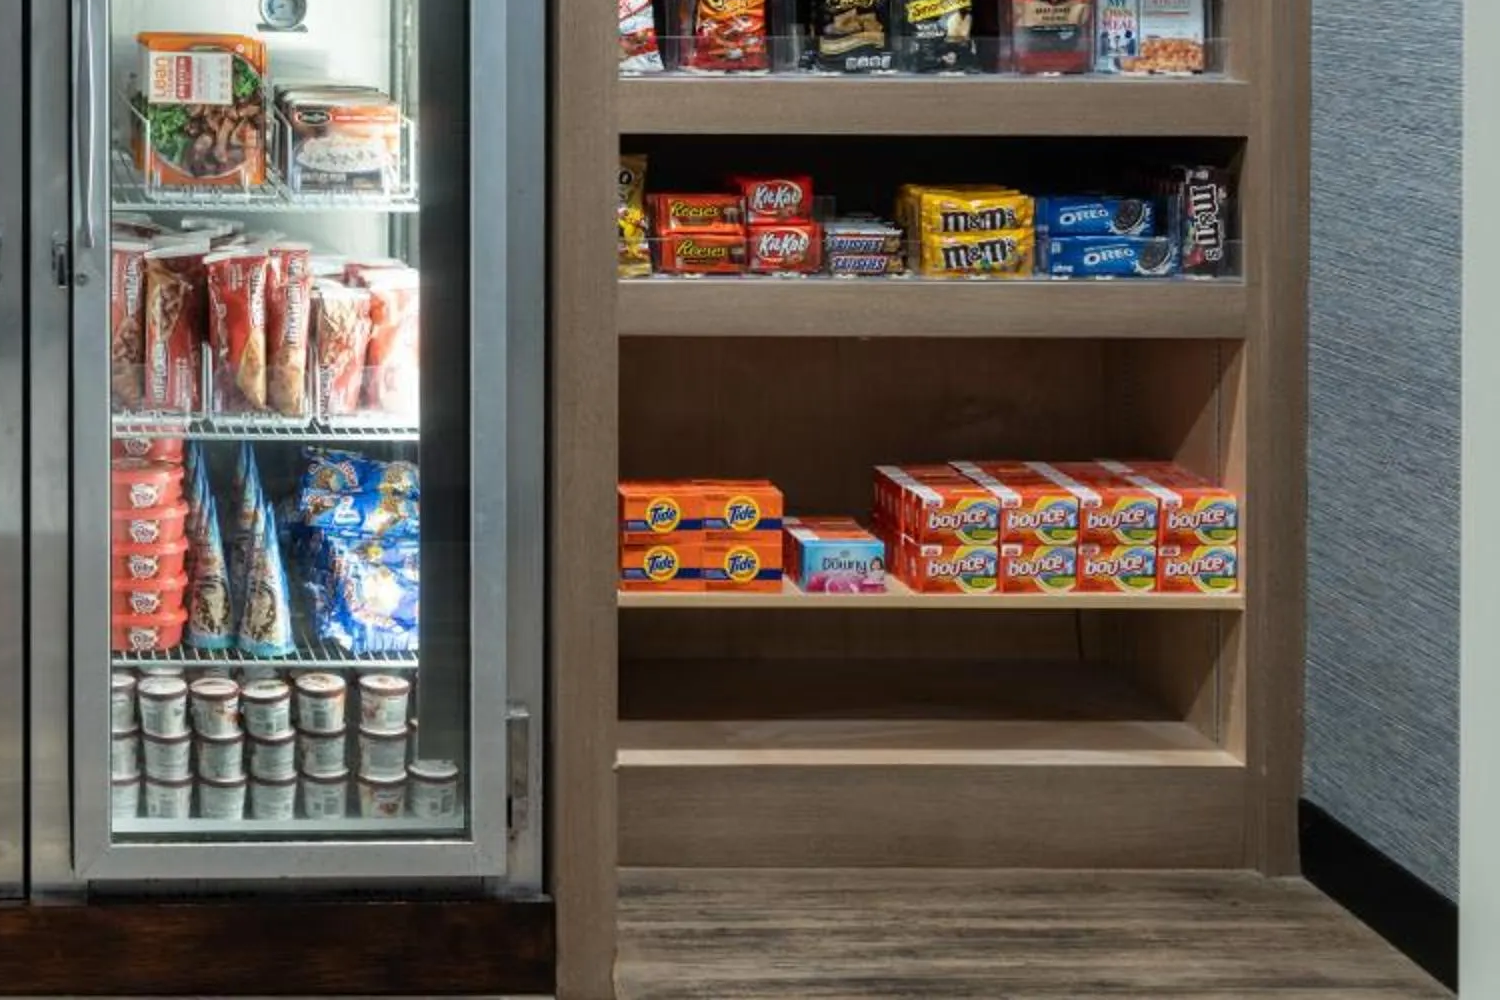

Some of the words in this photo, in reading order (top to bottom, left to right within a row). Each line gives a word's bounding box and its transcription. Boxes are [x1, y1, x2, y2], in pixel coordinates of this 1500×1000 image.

[1059, 210, 1109, 225] OREO
[1083, 248, 1134, 266] OREO
[650, 507, 677, 525] Tide
[729, 505, 756, 524] Tide
[929, 509, 987, 529] bounce
[1008, 509, 1066, 528] bounce
[1088, 509, 1145, 528] bounce
[1169, 509, 1225, 528] bounce
[648, 554, 675, 573] Tide
[729, 556, 756, 574] Tide
[822, 556, 867, 575] Downy
[928, 557, 985, 576] bounce
[1008, 556, 1063, 576] bounce
[1086, 556, 1142, 576] bounce
[1166, 556, 1222, 576] bounce
